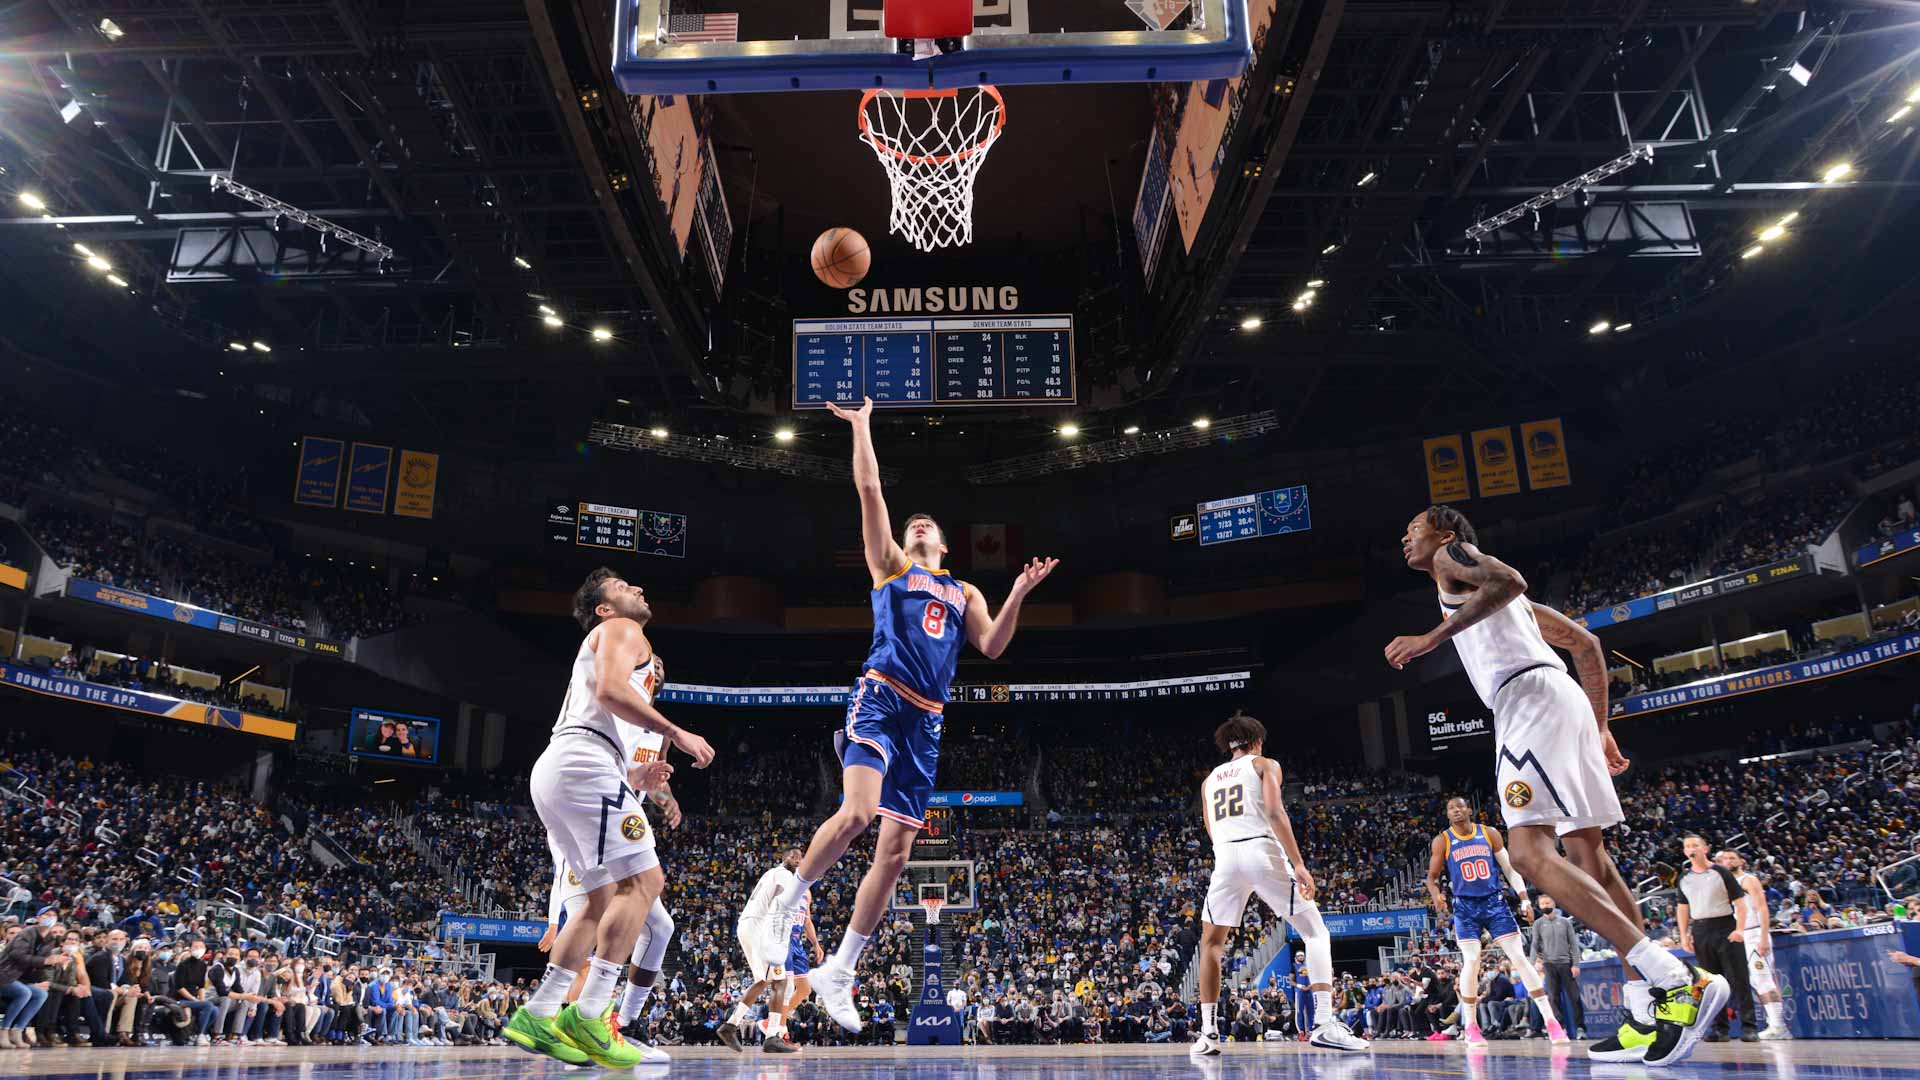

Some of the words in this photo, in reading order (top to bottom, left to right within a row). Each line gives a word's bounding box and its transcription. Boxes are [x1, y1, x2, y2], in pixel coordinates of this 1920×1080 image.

[848, 286, 1018, 313] SAMSUNG
[982, 333, 991, 341] 24
[1054, 332, 1059, 340] 3
[847, 347, 852, 355] 7
[1053, 343, 1059, 351] 11
[915, 357, 920, 365] 4
[982, 356, 992, 364] 24
[1052, 354, 1060, 363] 15
[984, 367, 992, 375] 10
[905, 380, 920, 388] 44.4
[1045, 377, 1061, 386] 46.3
[1682, 589, 1700, 600] ALST
[1702, 585, 1713, 595] 53
[1770, 564, 1800, 577] FINAL
[922, 599, 948, 639] 8
[242, 625, 259, 635] ALST
[260, 630, 270, 639] 53
[315, 642, 339, 653] FINAL
[1641, 691, 1686, 709] STREAM
[1691, 684, 1722, 698] YOUR
[1803, 650, 1871, 677] DOWNLOAD
[1875, 642, 1900, 658] THE
[15, 671, 79, 696] DOWNLOAD
[86, 688, 107, 701] THE
[112, 694, 138, 707] APP.
[973, 688, 986, 700] 79
[1015, 692, 1023, 700] 24
[1035, 692, 1039, 700] 7
[1050, 692, 1059, 700] 24
[1104, 691, 1111, 699] 11
[1121, 691, 1129, 699] 15
[1428, 711, 1446, 723] 5G
[1429, 722, 1455, 736] built
[1456, 718, 1484, 732] right
[634, 746, 660, 764] GGET
[974, 795, 997, 804] pepsi
[1213, 783, 1245, 822] 22
[924, 810, 946, 819] 8:41
[1452, 844, 1491, 863] WARRIORS
[1460, 858, 1490, 882] 00
[1361, 917, 1383, 927] NBC
[1398, 914, 1421, 922] CHANNEL
[447, 921, 466, 930] NBC
[512, 925, 532, 934] NBC
[1863, 926, 1887, 936] CHASE
[1801, 962, 1872, 991] CHANNEL
[1872, 960, 1888, 988] 11
[1807, 993, 1854, 1020] CABLE
[1855, 992, 1868, 1019] 3
[915, 1016, 952, 1026] KIA
[1584, 1015, 1593, 1024] AY
